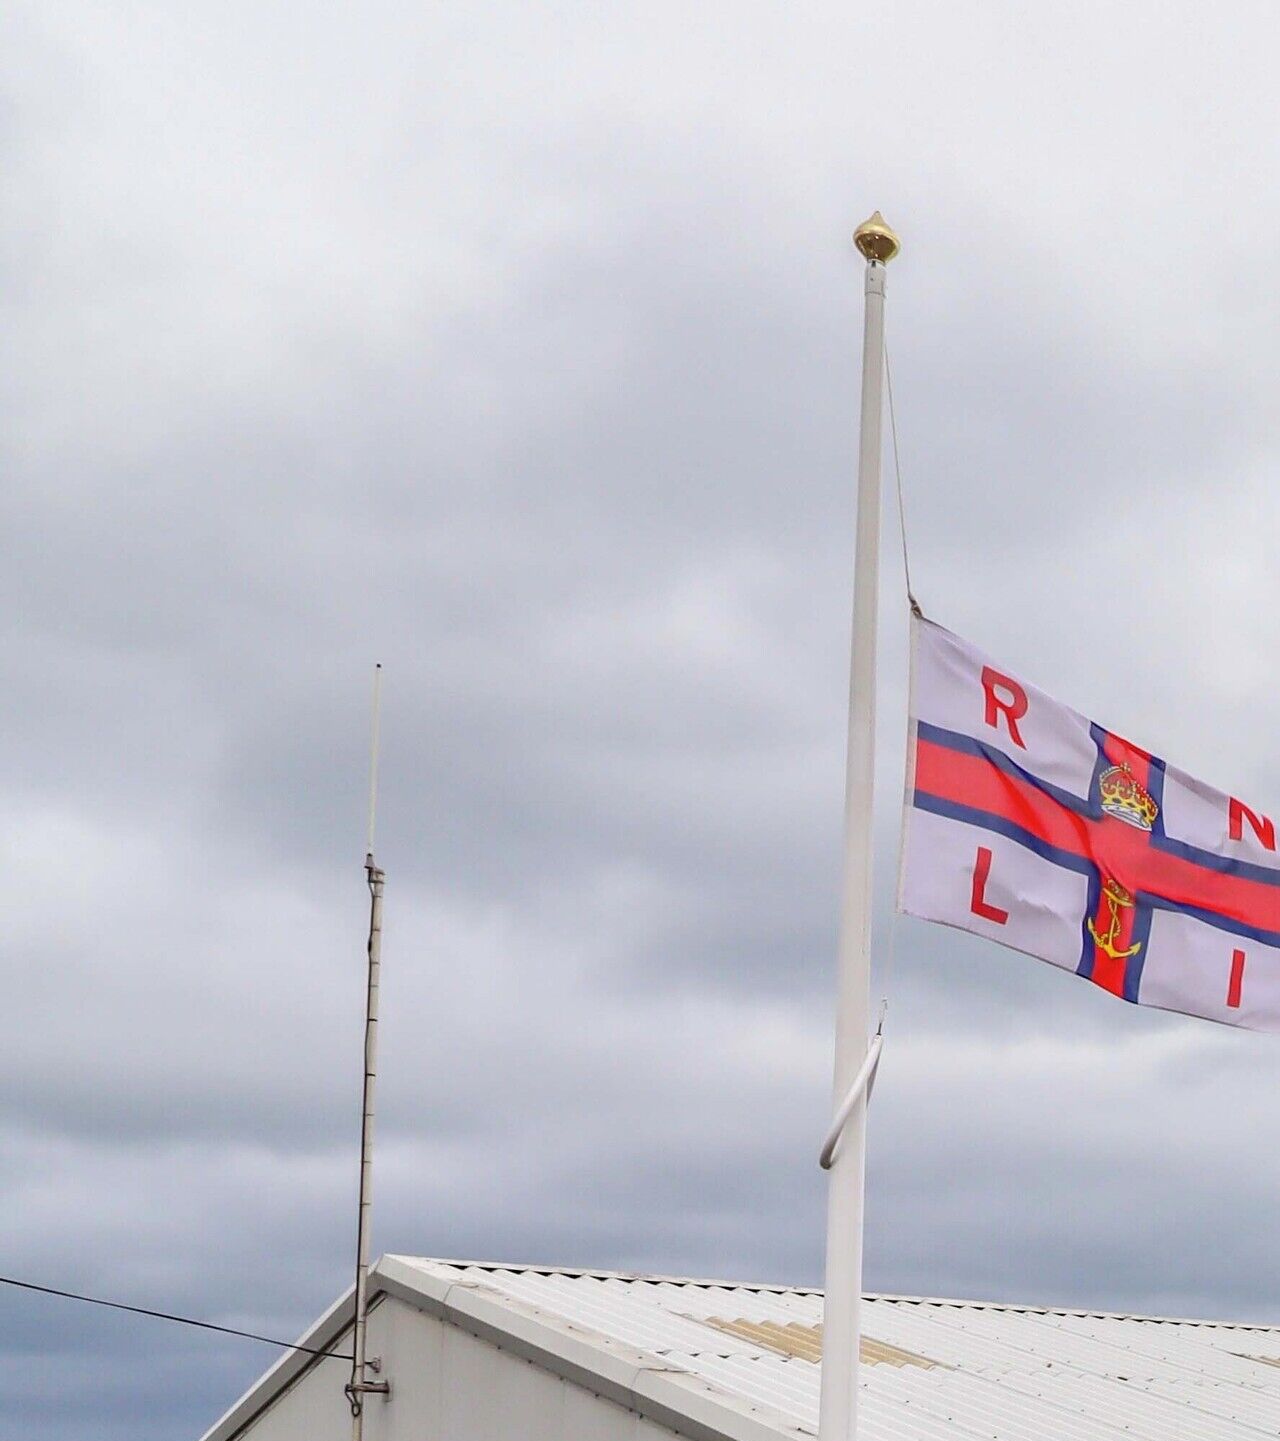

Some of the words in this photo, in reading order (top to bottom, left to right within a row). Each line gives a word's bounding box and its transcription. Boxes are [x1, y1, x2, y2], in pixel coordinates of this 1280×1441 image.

[981, 666, 1028, 750] R
[1229, 797, 1276, 851] N
[970, 847, 1009, 925] L
[1227, 949, 1245, 1009] I
